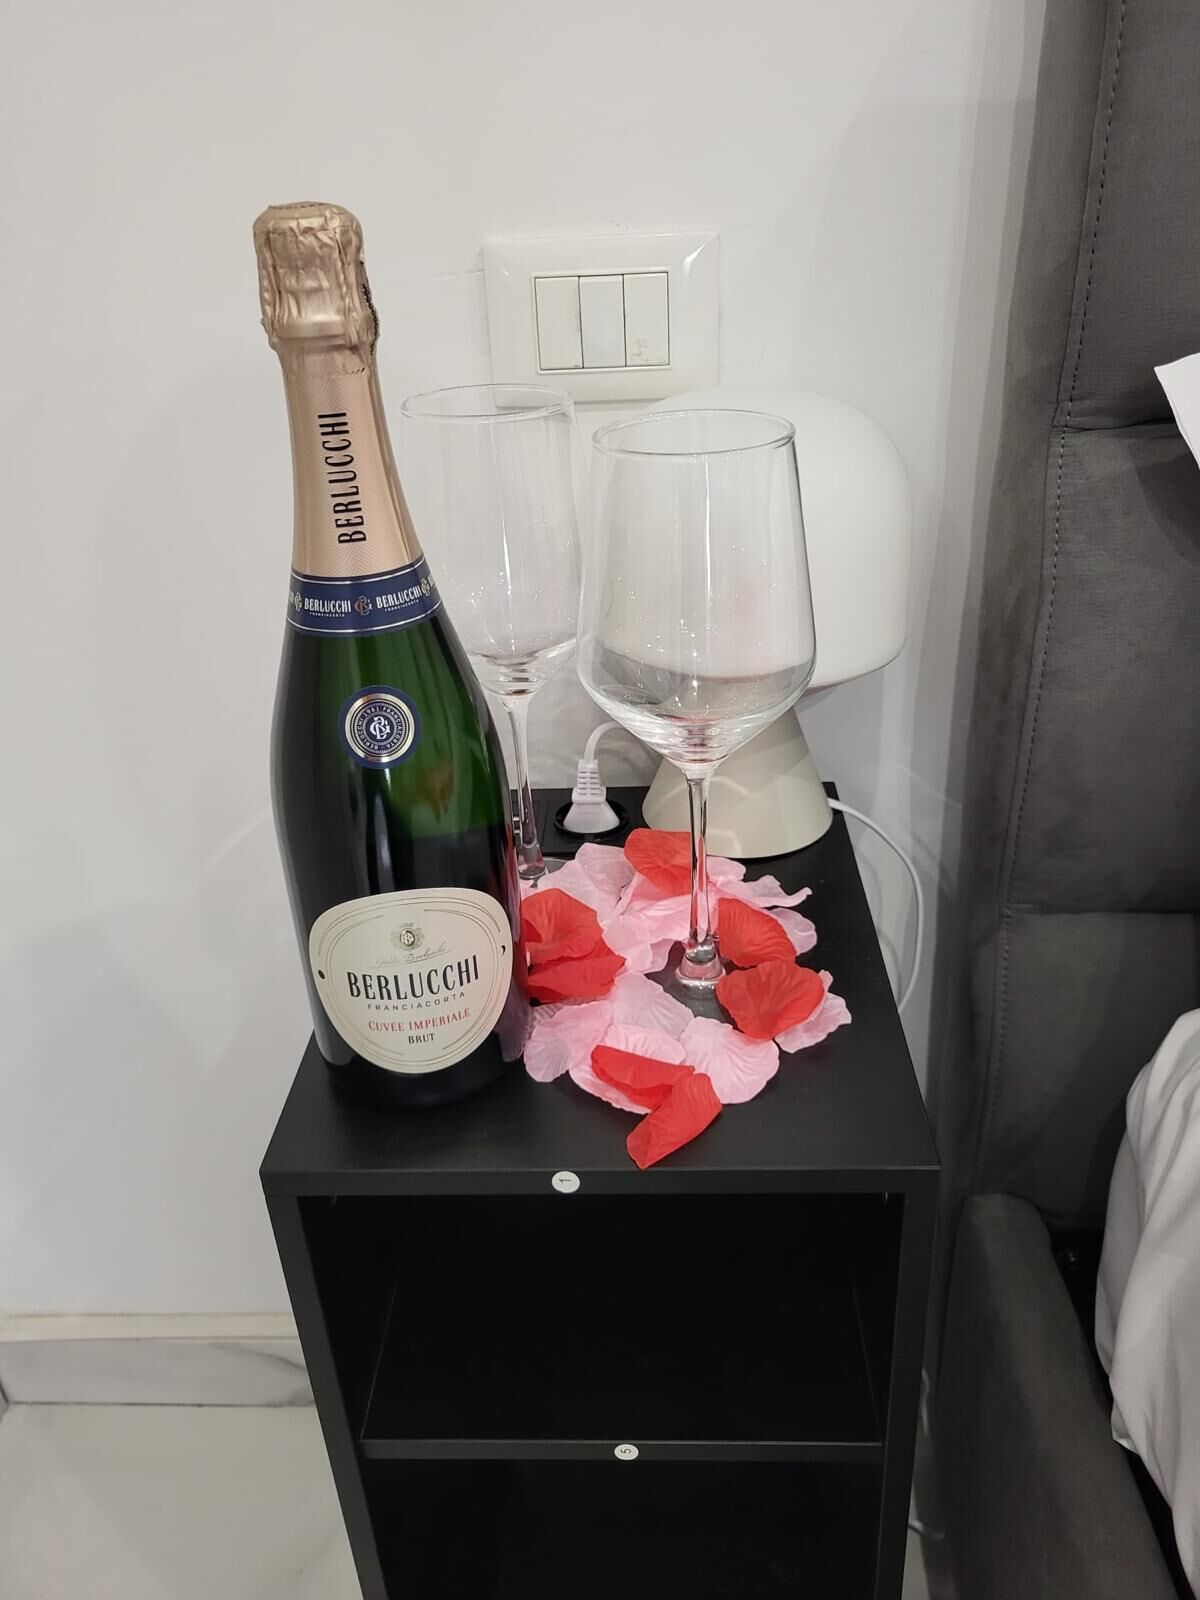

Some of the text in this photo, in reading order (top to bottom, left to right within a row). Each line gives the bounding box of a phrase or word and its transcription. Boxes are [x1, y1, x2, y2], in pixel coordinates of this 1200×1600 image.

[317, 412, 367, 544] BERLUCCHI
[304, 598, 352, 613] BERLUCCHI
[376, 586, 422, 609] BERLUCCHI
[347, 954, 479, 1001] BERLUCCHI
[367, 991, 466, 1011] FRANCIACORTA
[409, 1007, 471, 1031] IMPERIALE
[408, 1032, 436, 1044] BRUT
